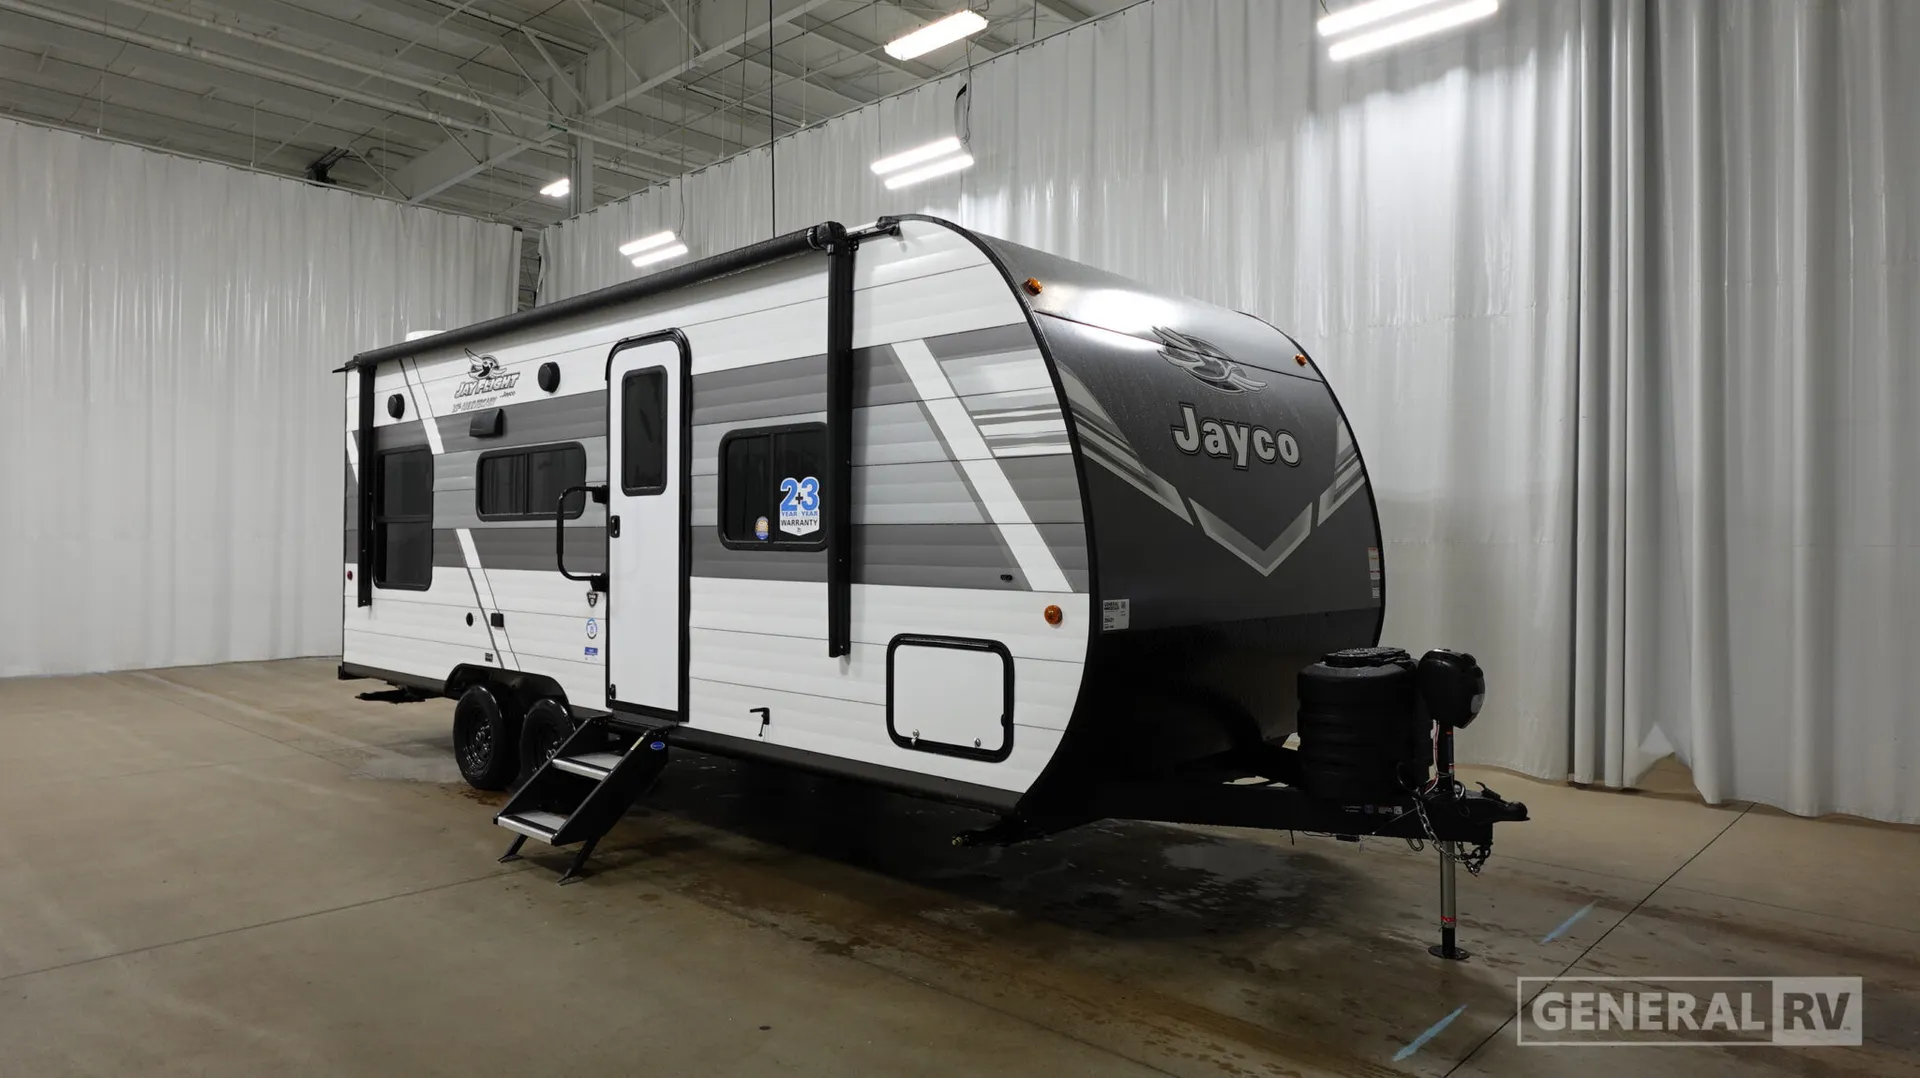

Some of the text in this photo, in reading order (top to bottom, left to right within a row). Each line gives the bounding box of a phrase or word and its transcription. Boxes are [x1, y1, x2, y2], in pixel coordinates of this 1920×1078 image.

[454, 373, 520, 398] JAY FLIGHT
[1171, 402, 1301, 470] Jayco
